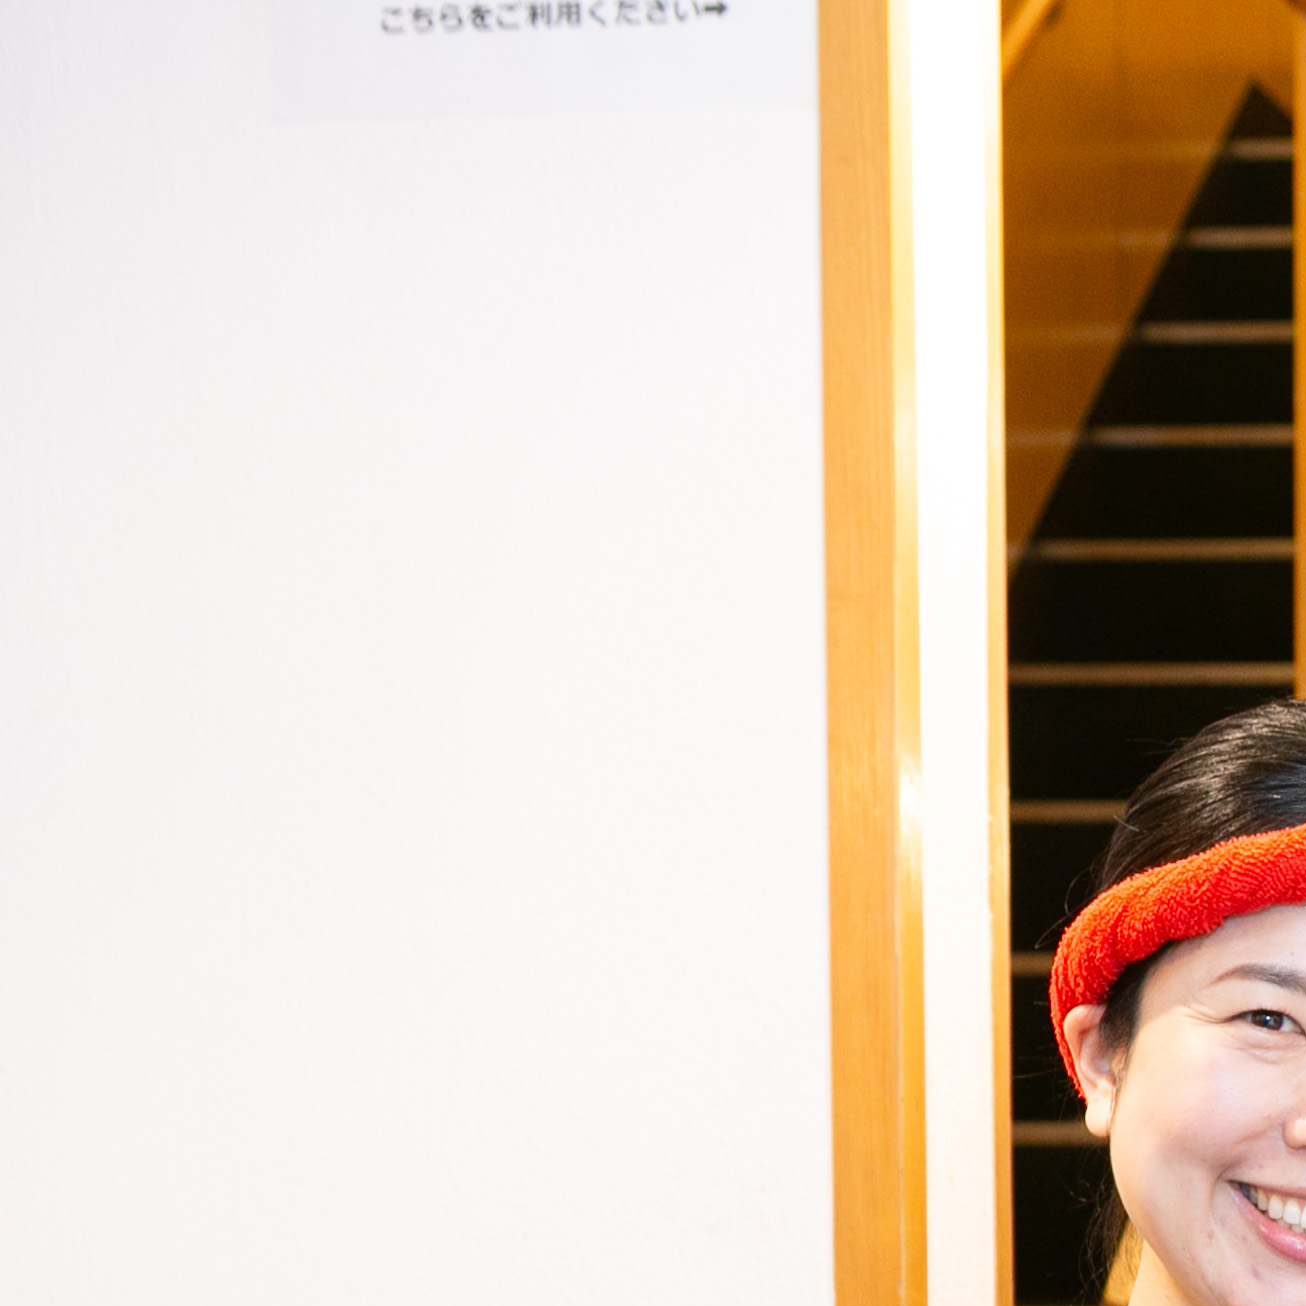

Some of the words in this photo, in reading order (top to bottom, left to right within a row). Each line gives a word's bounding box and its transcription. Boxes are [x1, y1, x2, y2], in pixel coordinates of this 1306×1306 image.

[380, 1, 700, 33] こちらをご利用ください
